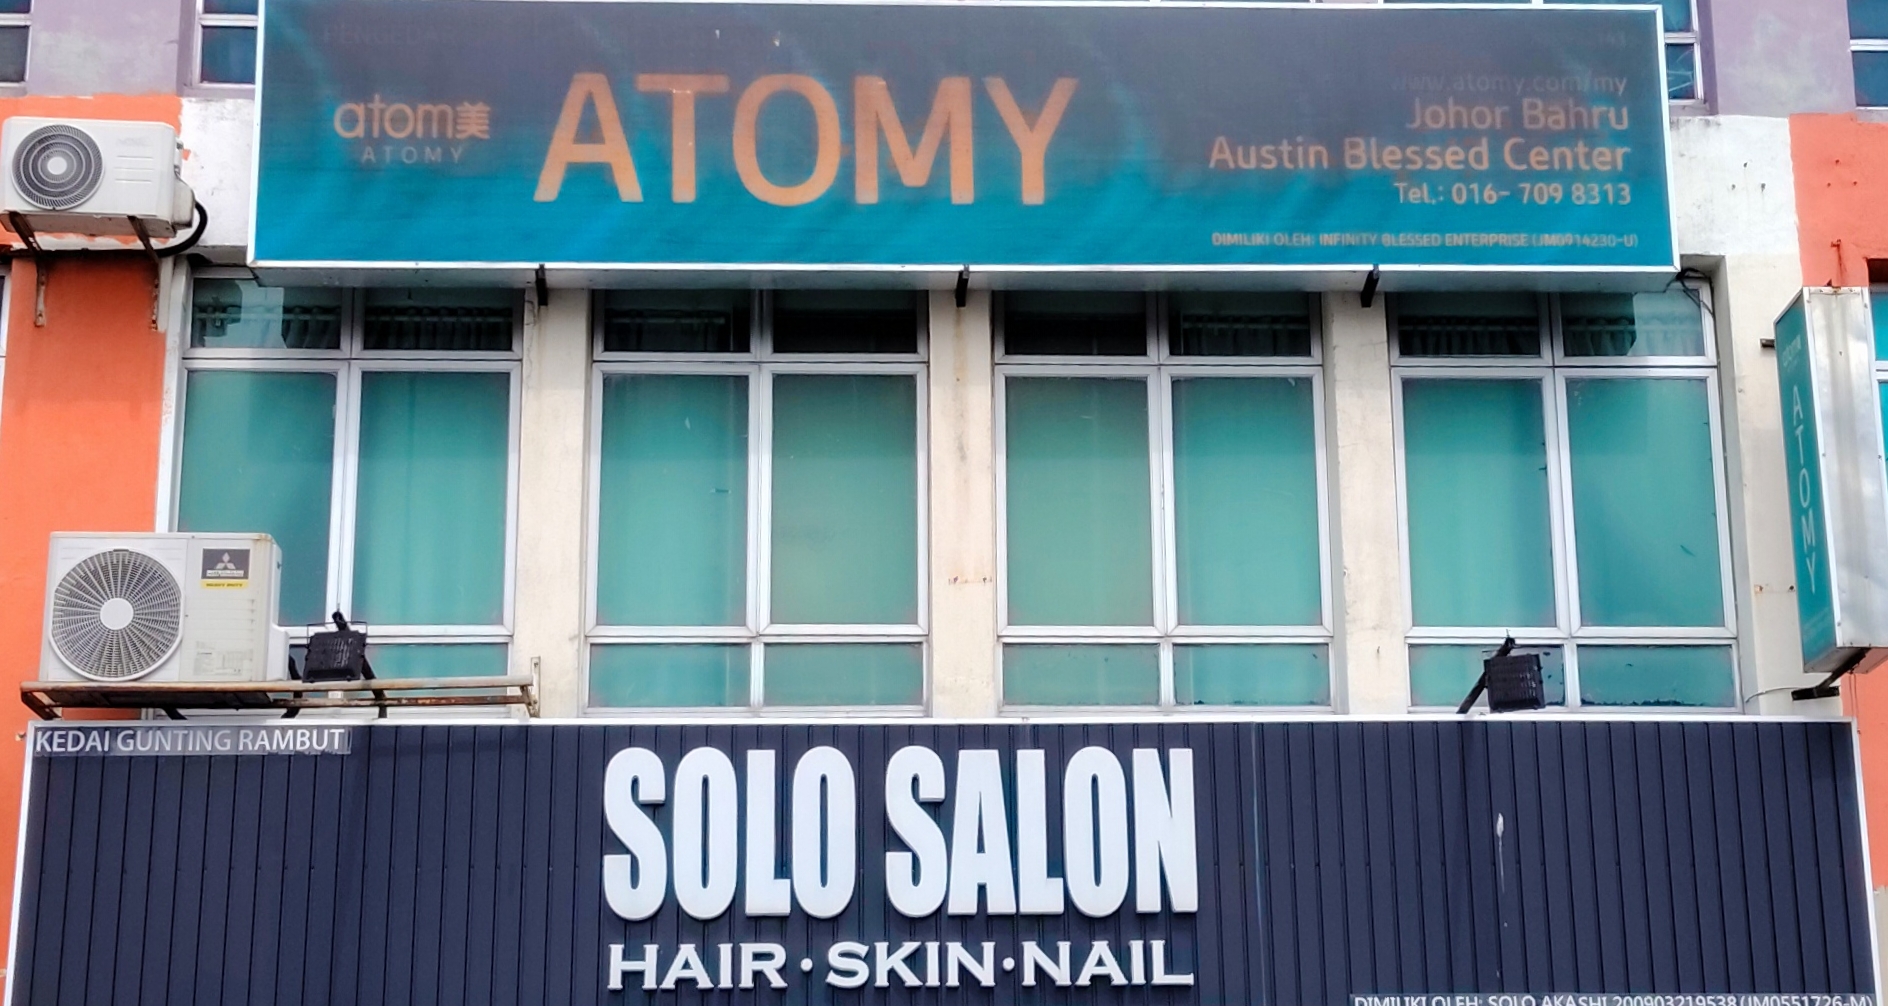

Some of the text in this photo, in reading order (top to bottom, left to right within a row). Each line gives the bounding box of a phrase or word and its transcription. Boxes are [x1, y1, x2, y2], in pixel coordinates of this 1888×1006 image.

[1406, 97, 1629, 130] Johor Bahru
[362, 146, 464, 164] ATOMY
[533, 73, 1079, 207] ATOMY
[1209, 137, 1631, 170] Austin Blessed Center
[1519, 183, 1563, 205] 709
[1571, 183, 1632, 205] 8313
[1211, 232, 1270, 246] DIMILIKI
[1319, 233, 1378, 247] INFINITY
[1382, 233, 1441, 247] BLESSED
[1445, 233, 1529, 247] ENTERPRISE
[1792, 384, 1817, 594] ATOMY
[36, 728, 345, 752] KEDAI GUNTING RAMBUT
[603, 745, 1198, 921] SOLO SALON
